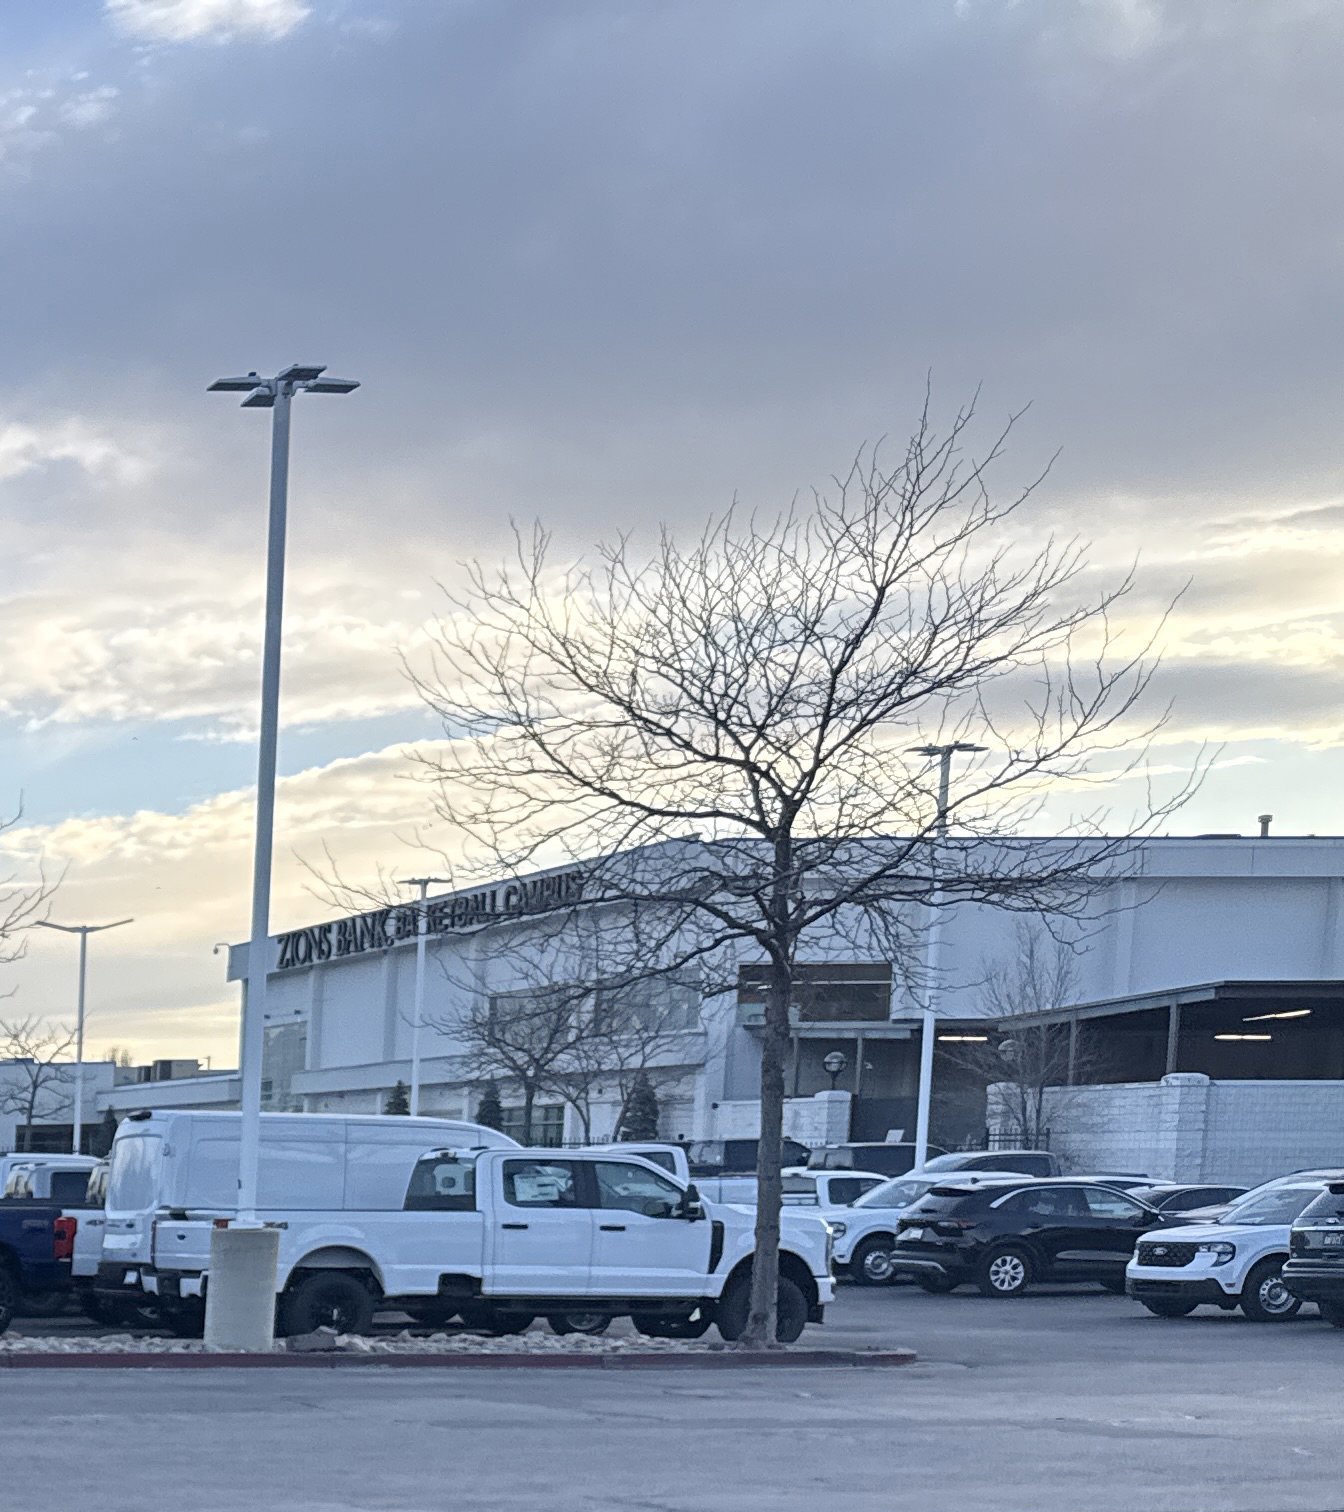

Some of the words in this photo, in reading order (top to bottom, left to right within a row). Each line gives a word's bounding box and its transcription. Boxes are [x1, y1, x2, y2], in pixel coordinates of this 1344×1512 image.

[276, 923, 333, 969] ZIONS
[335, 908, 389, 957] BANK
[395, 889, 499, 937] BAKETBALL
[503, 871, 582, 914] CAMPUS
